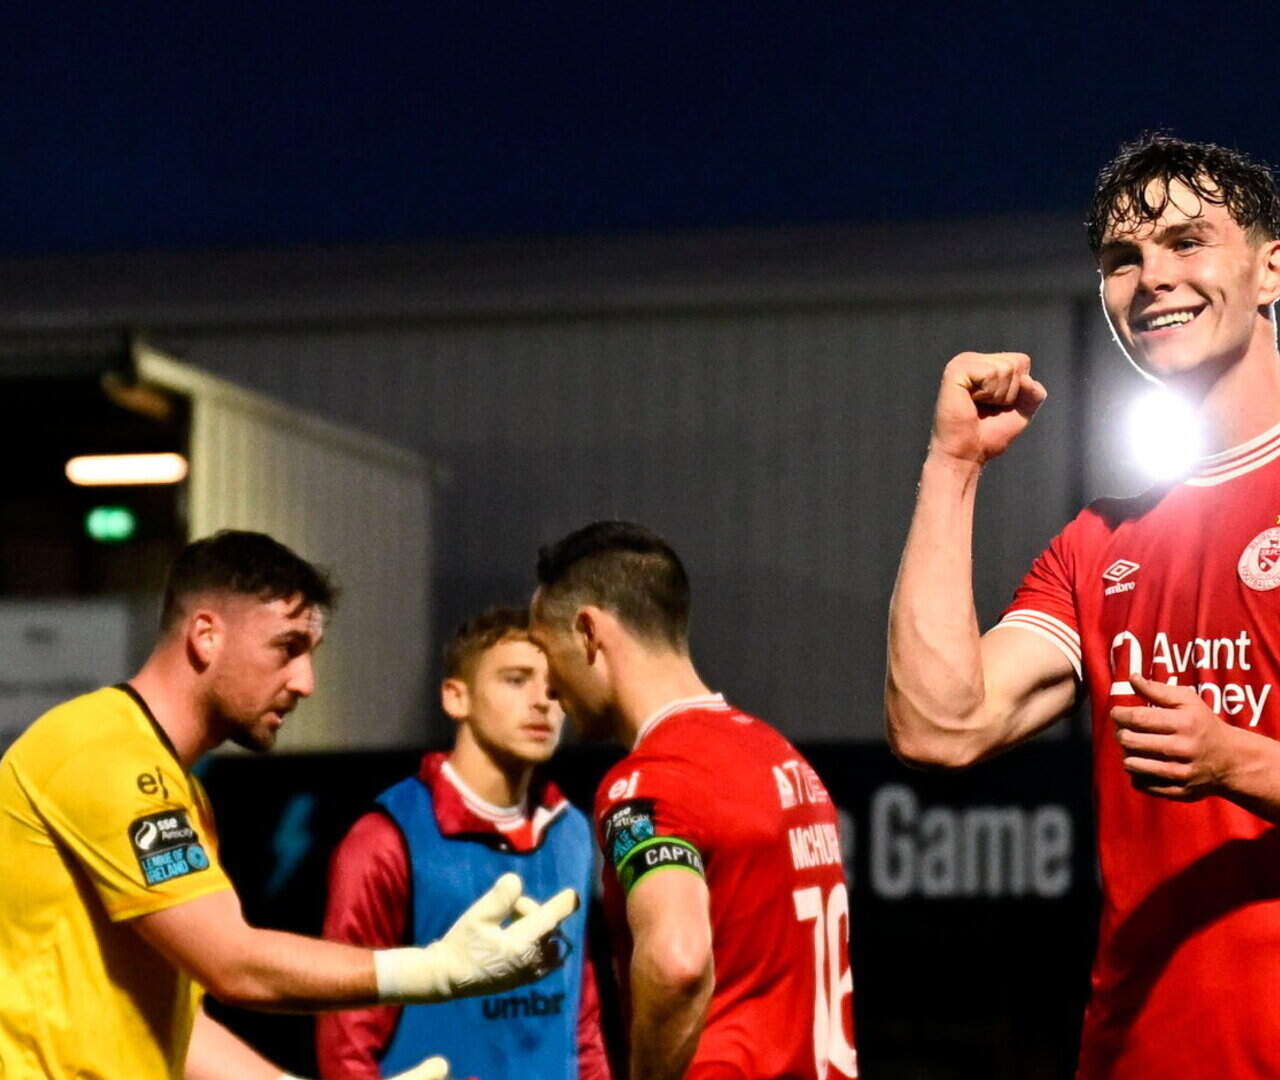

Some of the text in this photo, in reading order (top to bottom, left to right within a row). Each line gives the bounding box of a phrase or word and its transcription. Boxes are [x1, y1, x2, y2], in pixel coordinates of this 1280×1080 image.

[1104, 581, 1136, 597] umbro
[1150, 630, 1252, 676] Avant
[869, 781, 1074, 898] Game
